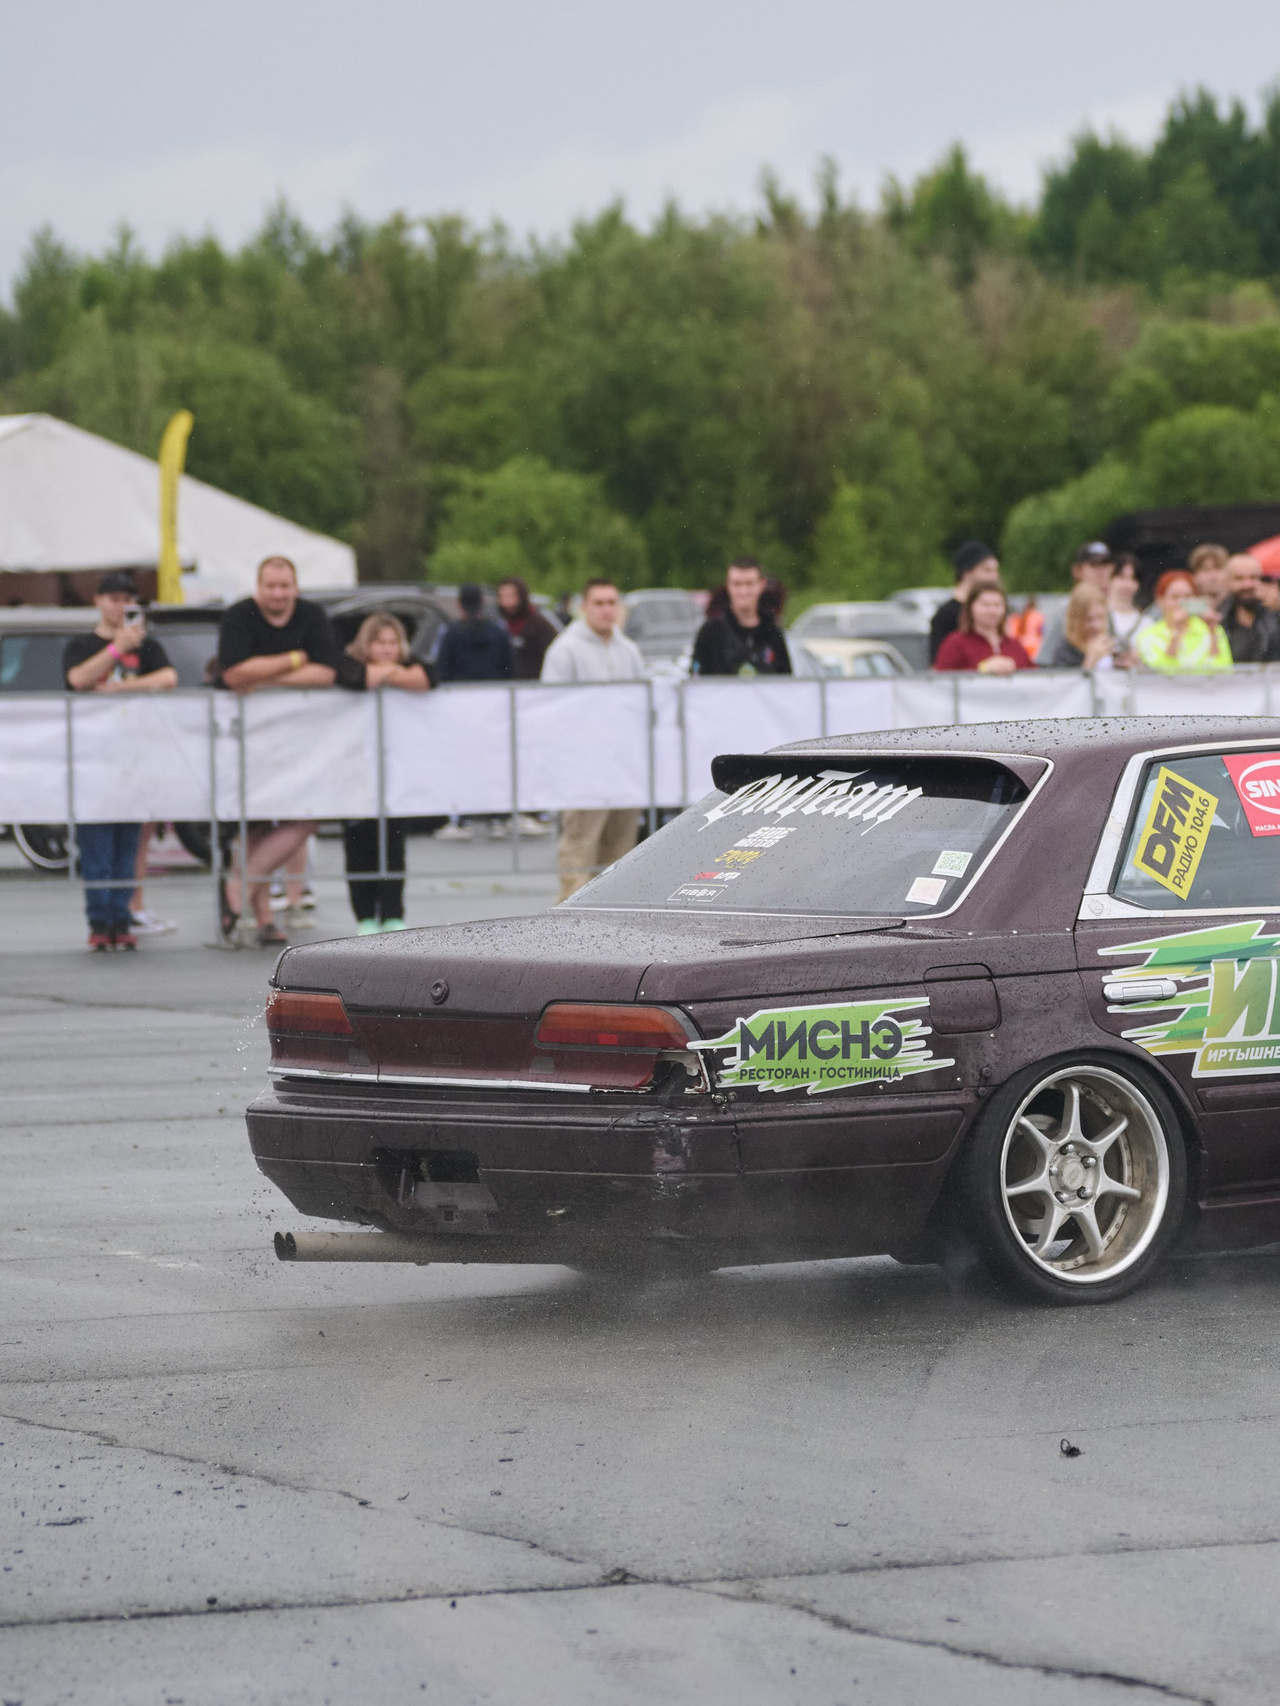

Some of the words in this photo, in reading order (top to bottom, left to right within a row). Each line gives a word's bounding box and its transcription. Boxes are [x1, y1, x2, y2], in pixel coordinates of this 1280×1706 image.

[1141, 776, 1195, 879] DFM
[1172, 835, 1198, 889] РАДИО
[1190, 796, 1210, 833] 104.6
[739, 1067, 810, 1080] РЕСТОРАН
[819, 1066, 901, 1080] ГОСТИНИЦА
[740, 1020, 902, 1061] МИСНЭ
